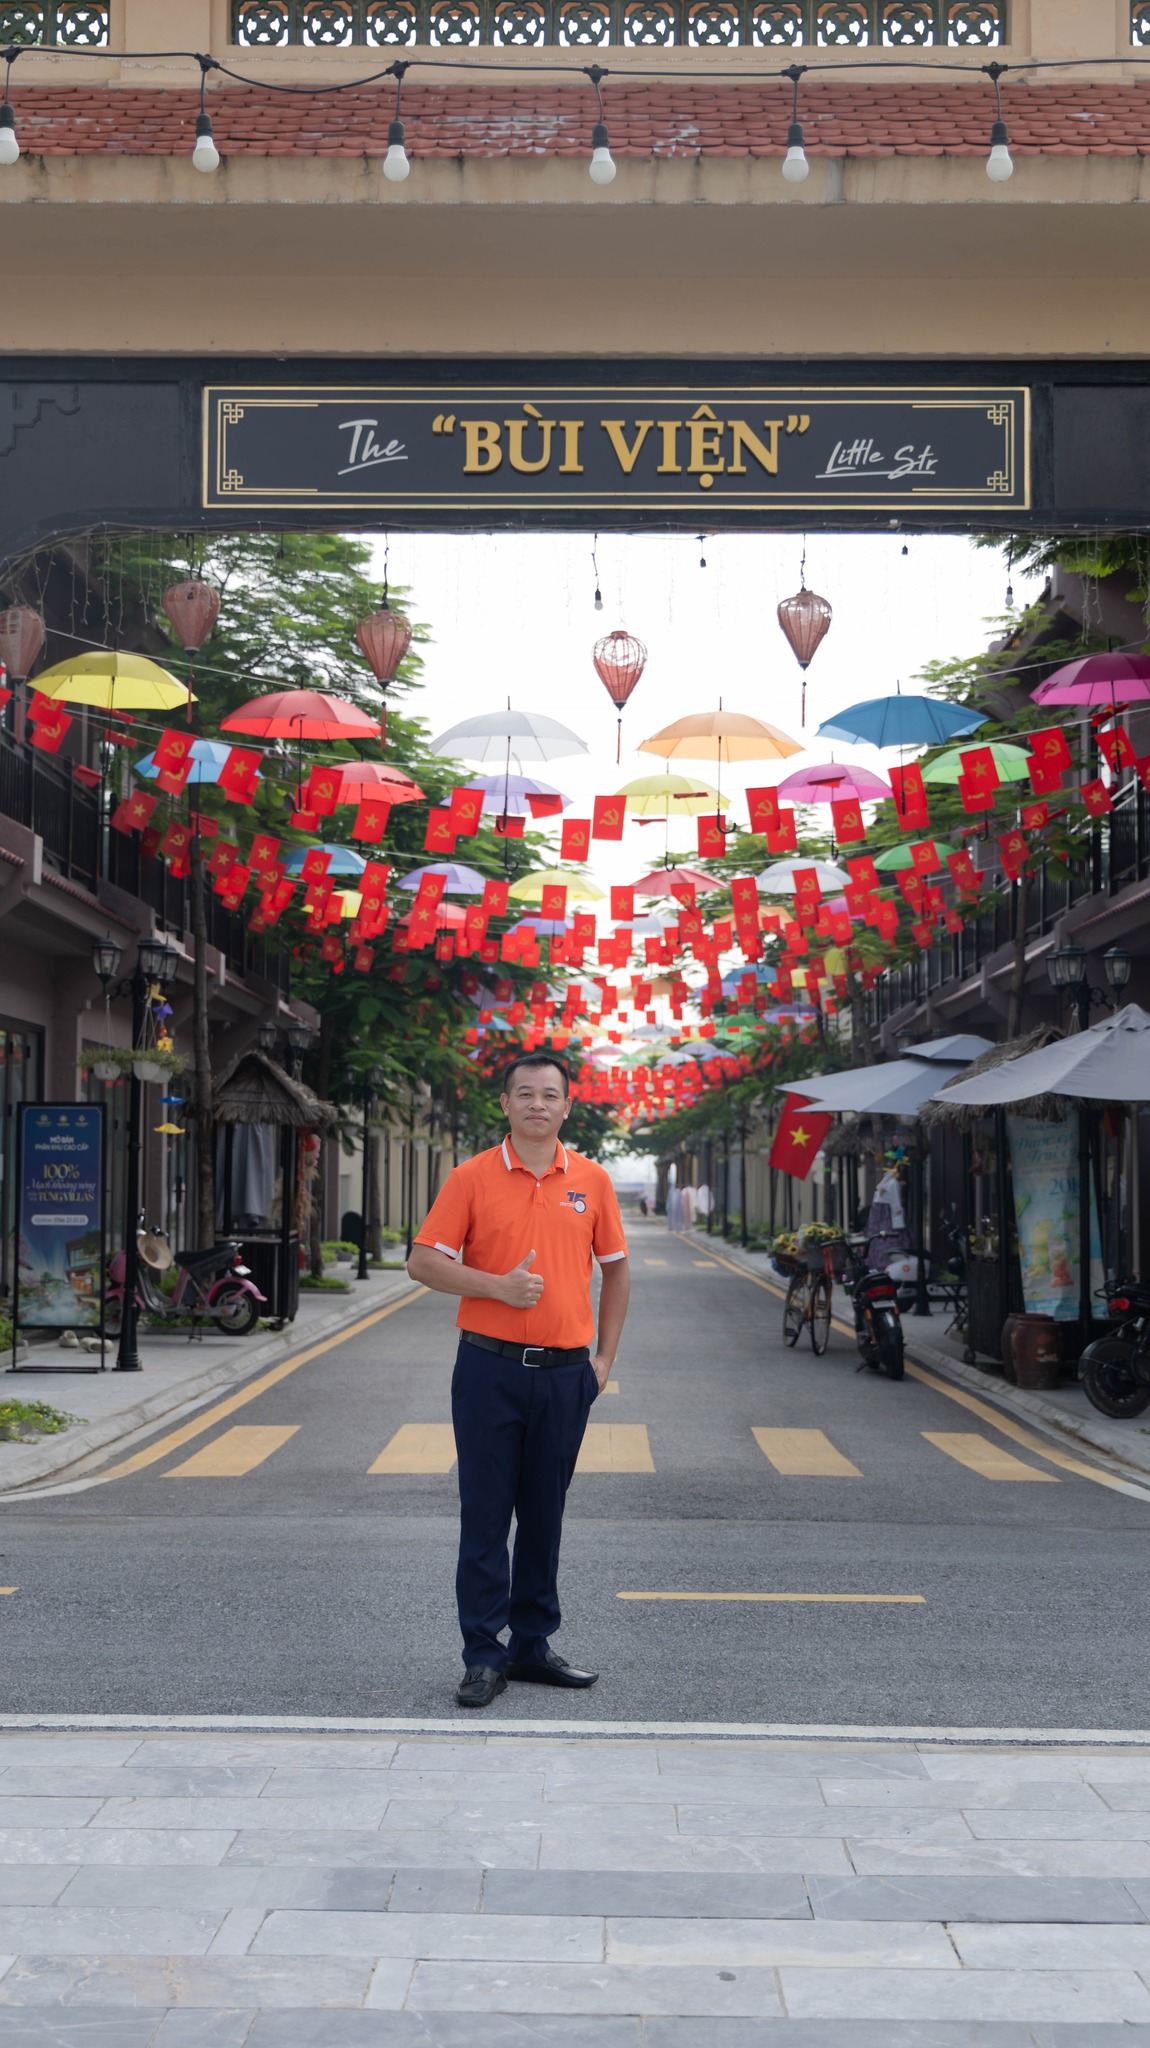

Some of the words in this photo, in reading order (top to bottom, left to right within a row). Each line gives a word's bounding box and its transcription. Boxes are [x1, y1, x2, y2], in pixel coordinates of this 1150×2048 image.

[338, 419, 406, 465] The
[826, 439, 884, 474] Little
[888, 445, 939, 480] Str
[43, 1164, 80, 1179] 100%
